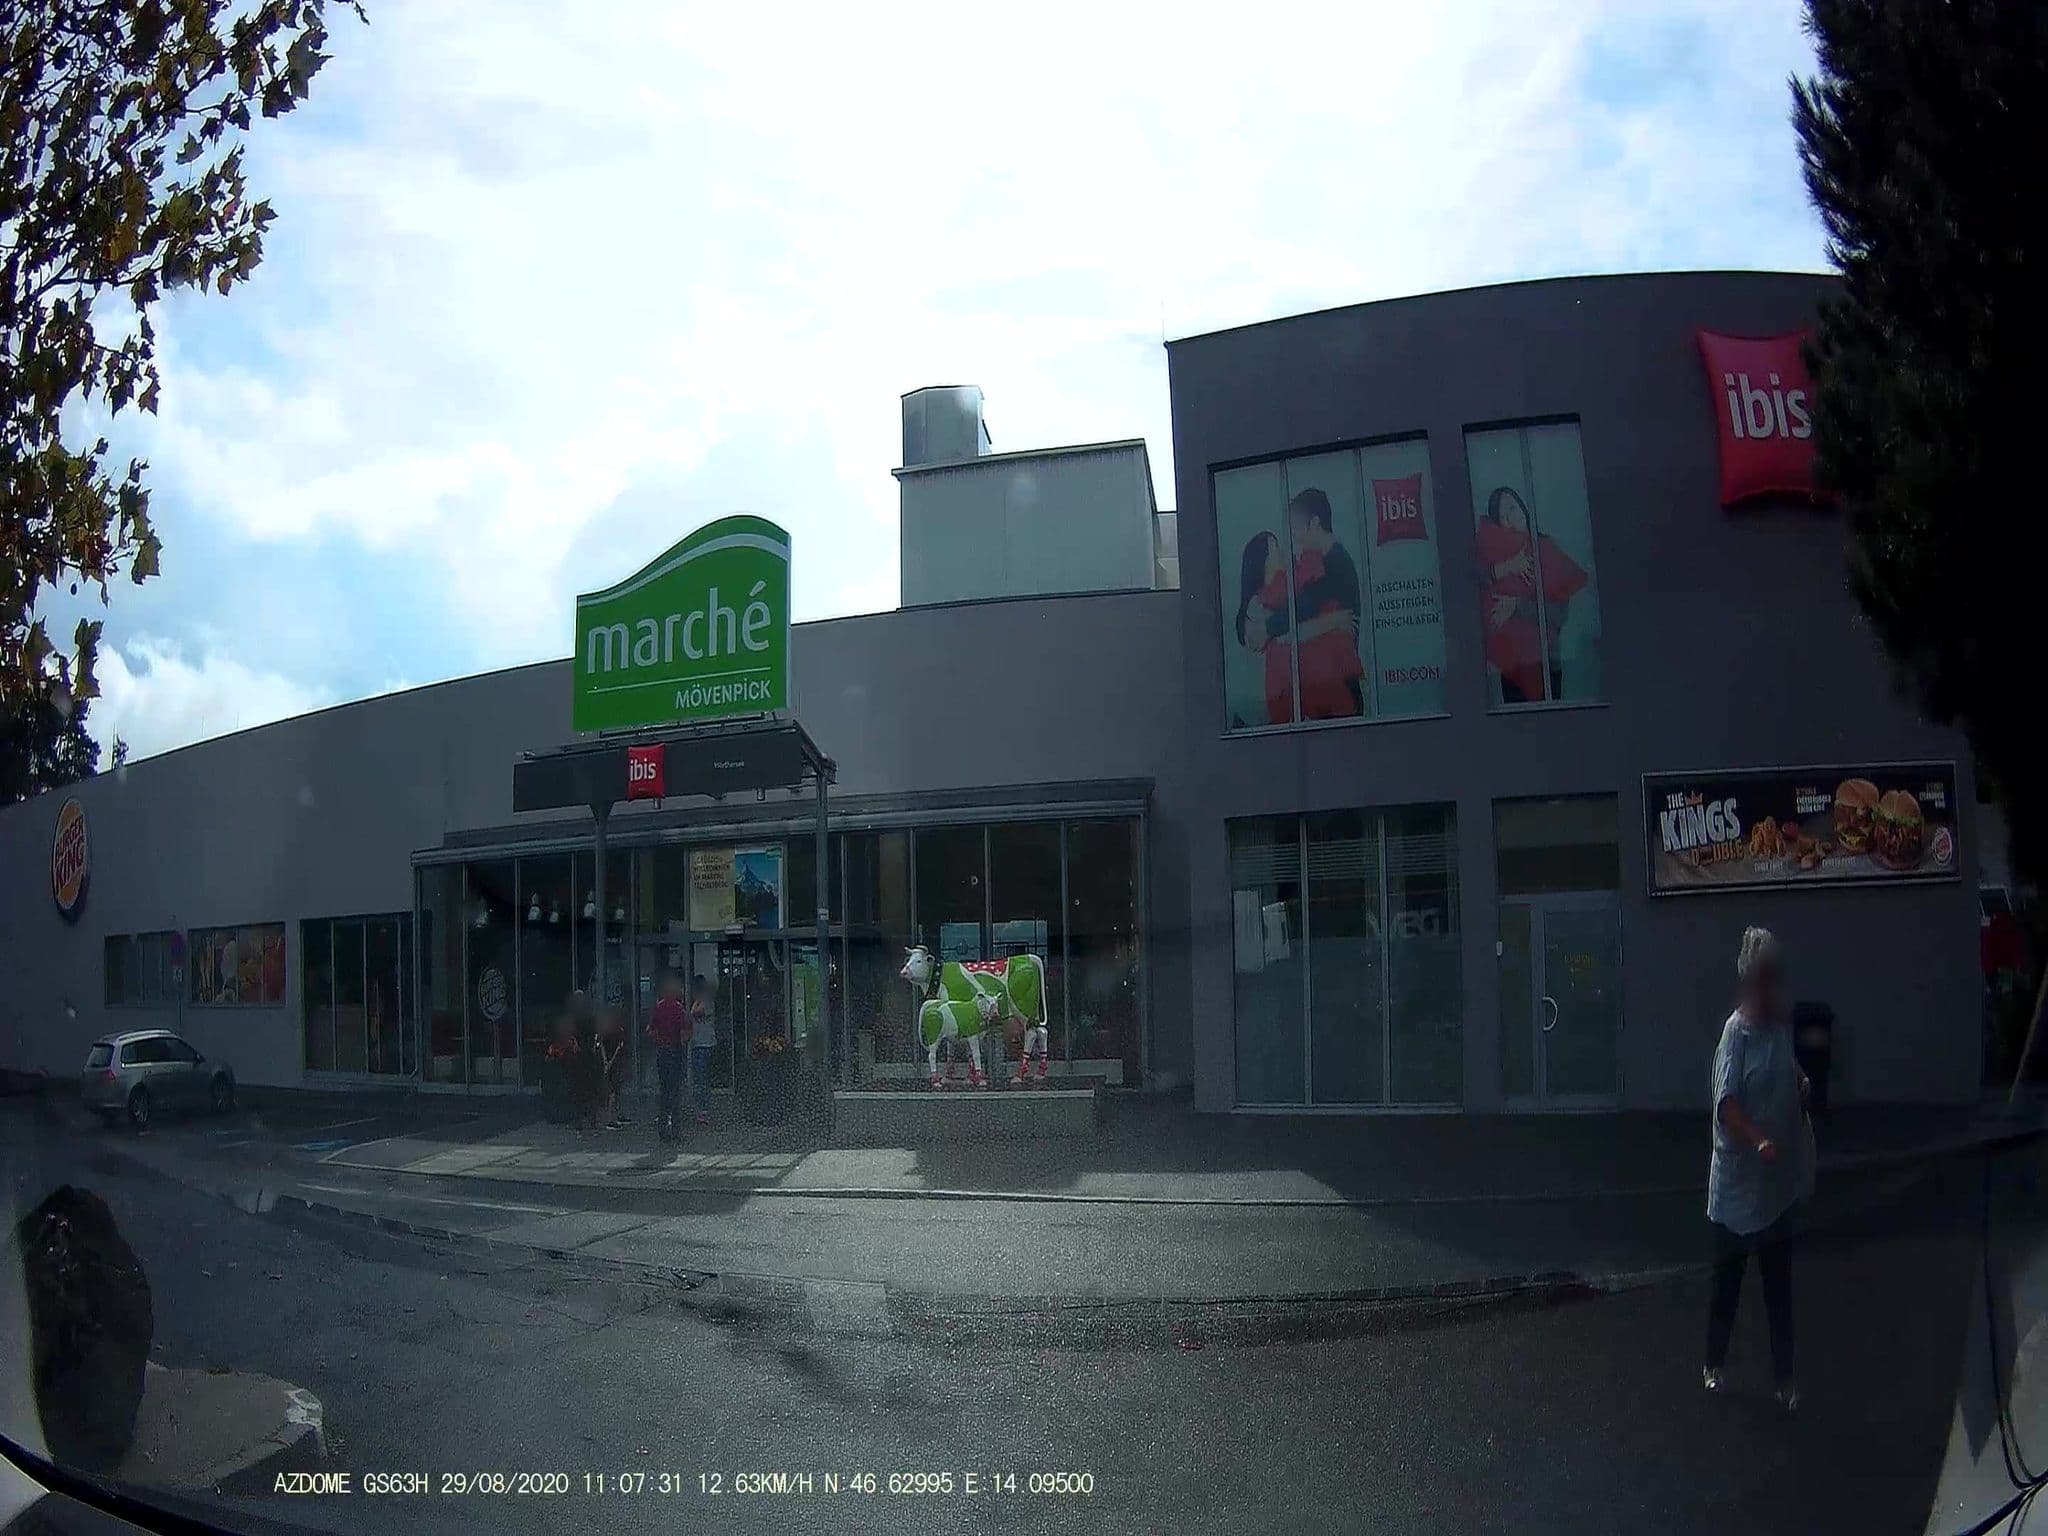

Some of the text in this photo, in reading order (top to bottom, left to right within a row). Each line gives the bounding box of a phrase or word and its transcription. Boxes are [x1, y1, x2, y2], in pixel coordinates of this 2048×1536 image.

[1723, 372, 1812, 440] ibis
[1380, 494, 1418, 522] ibis
[586, 580, 772, 675] marché
[675, 678, 773, 710] MÖVENPICK
[629, 759, 657, 782] ibis
[1666, 792, 1685, 810] THE
[1659, 797, 1741, 853] KINGS
[56, 836, 85, 896] KING
